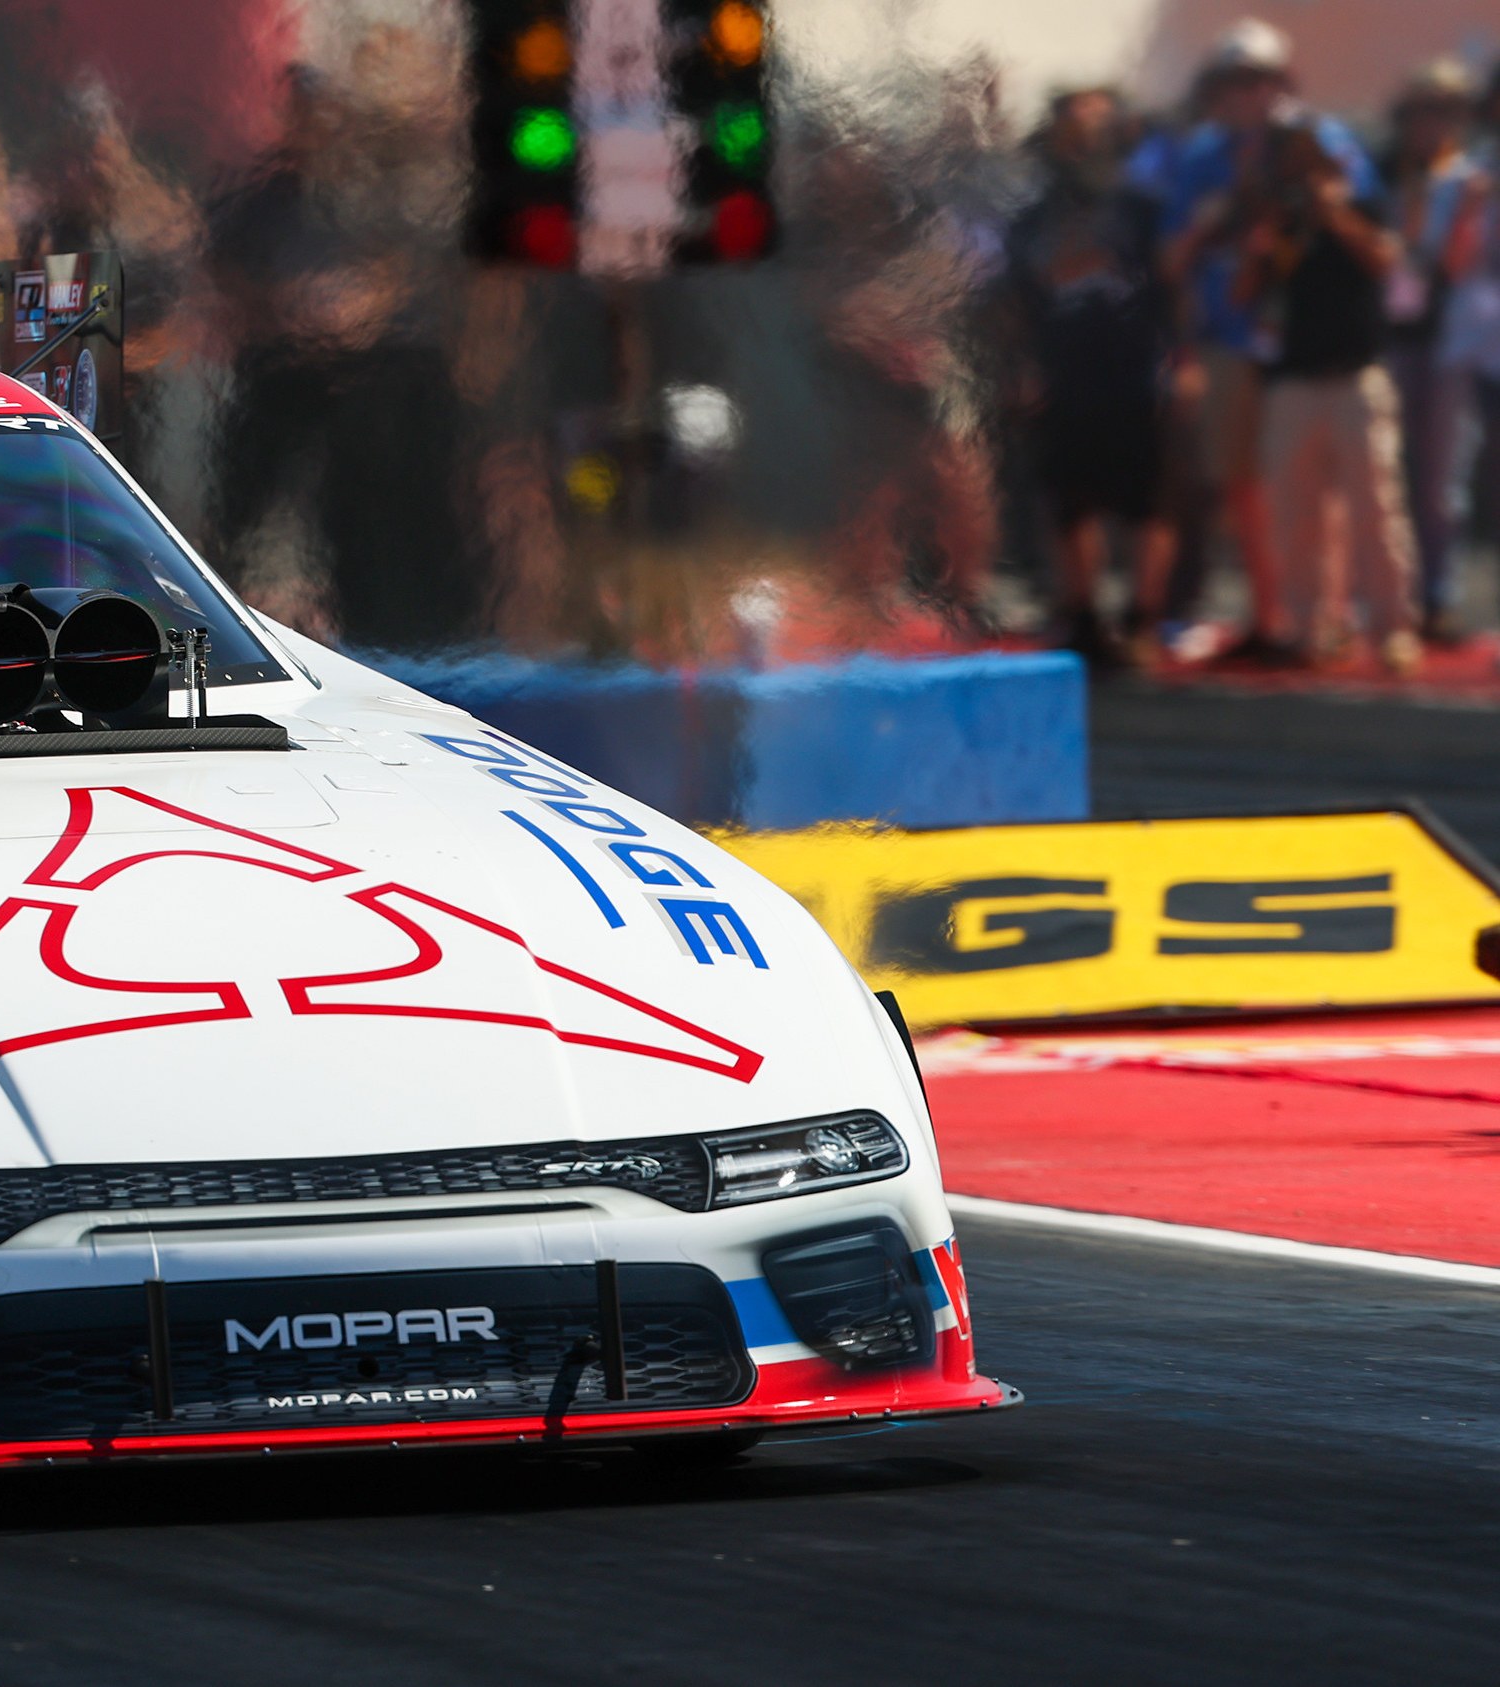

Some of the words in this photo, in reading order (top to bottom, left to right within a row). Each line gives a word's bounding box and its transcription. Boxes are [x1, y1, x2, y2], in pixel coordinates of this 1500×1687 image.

[412, 732, 770, 970] DODGE
[539, 1160, 635, 1175] SRT
[225, 1306, 499, 1353] MOPAR
[268, 1387, 477, 1408] MOPAR.COM
